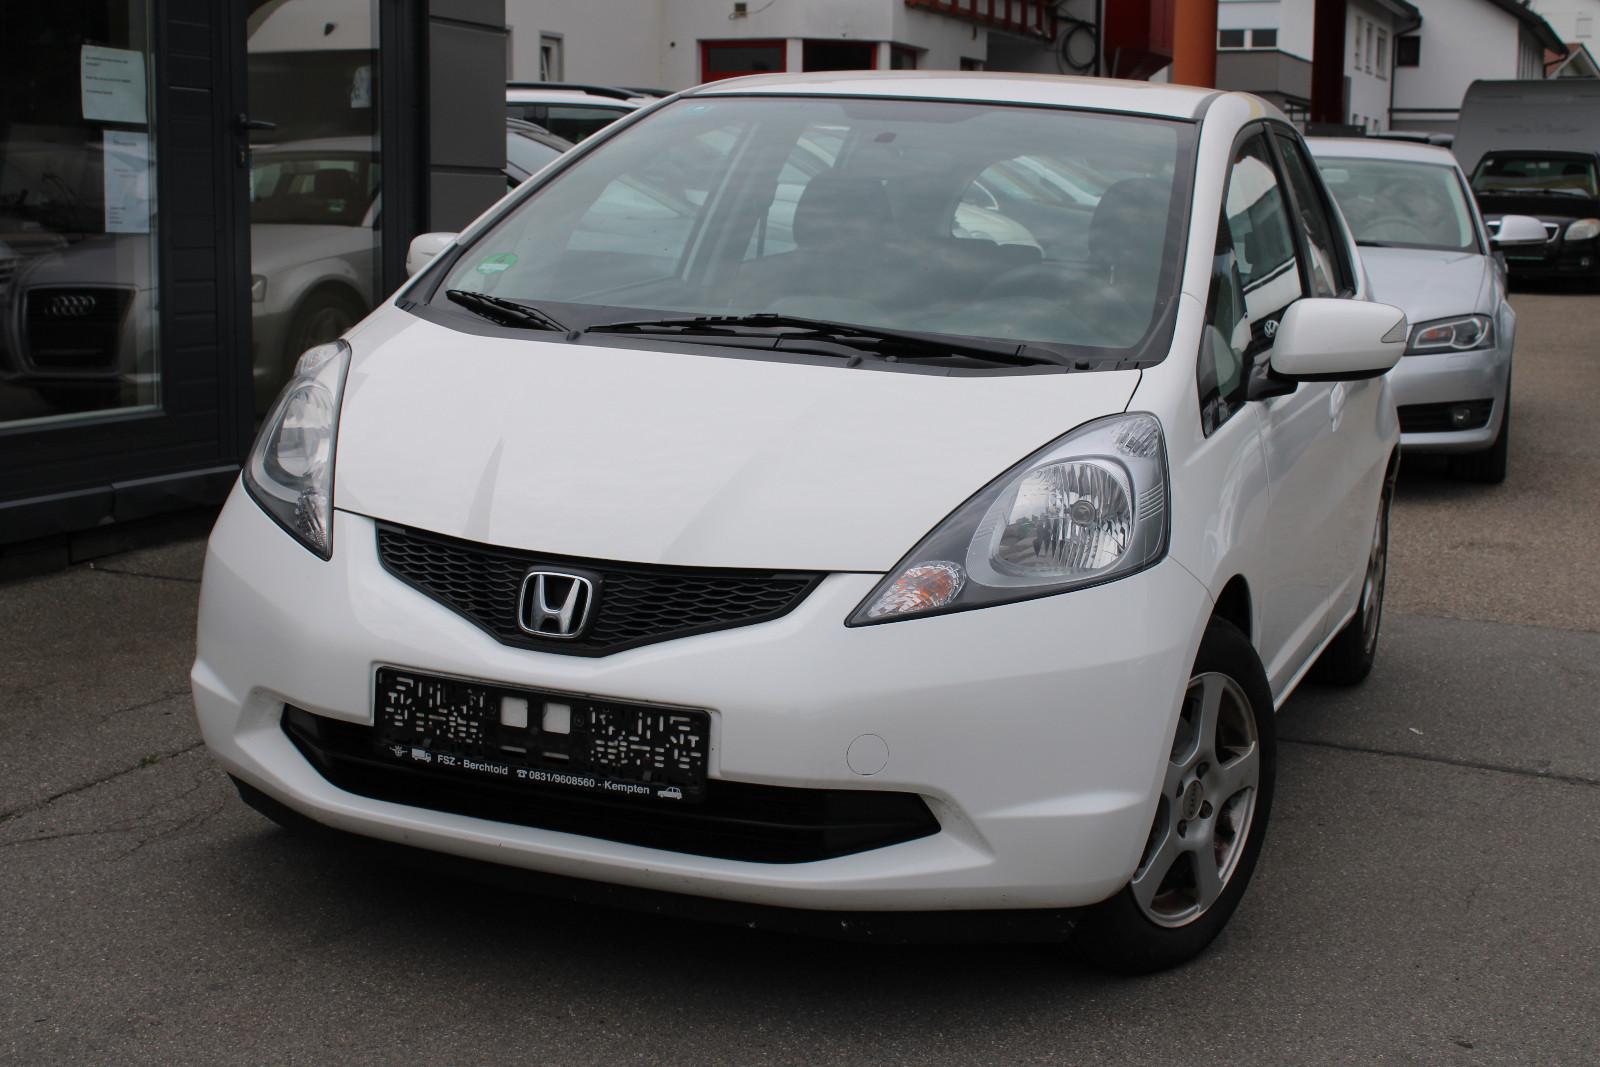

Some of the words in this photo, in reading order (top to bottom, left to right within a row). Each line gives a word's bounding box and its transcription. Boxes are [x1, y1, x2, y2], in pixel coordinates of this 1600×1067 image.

[437, 754, 456, 766] FSZ
[463, 759, 509, 775] Berchtold
[529, 770, 595, 788] 0831/9608560
[604, 780, 650, 795] Kempten
